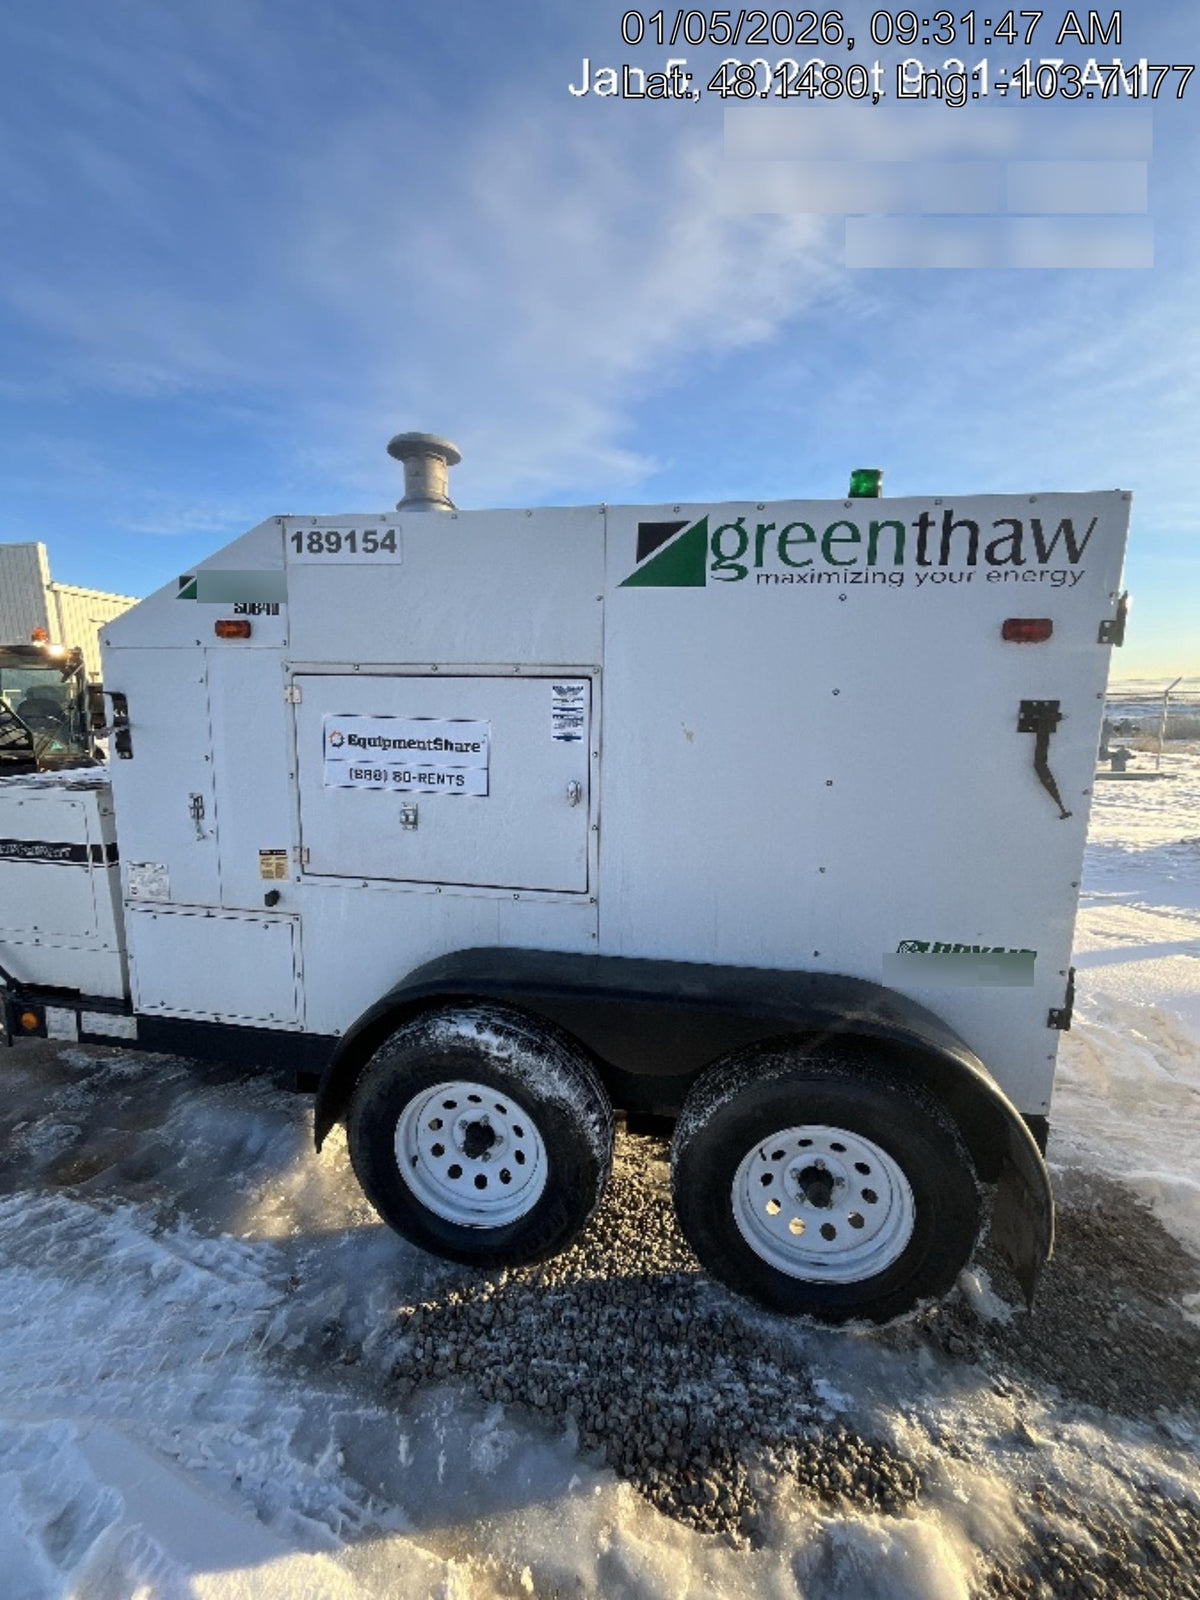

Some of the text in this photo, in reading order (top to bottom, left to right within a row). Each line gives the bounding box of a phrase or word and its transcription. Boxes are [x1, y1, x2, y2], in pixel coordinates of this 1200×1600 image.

[290, 529, 397, 554] 189154
[710, 509, 1098, 582] greenthaw
[755, 566, 1086, 588] maximizing your energy
[347, 733, 482, 753] EquipmentShare
[349, 767, 466, 787] (888) 80-RENTS
